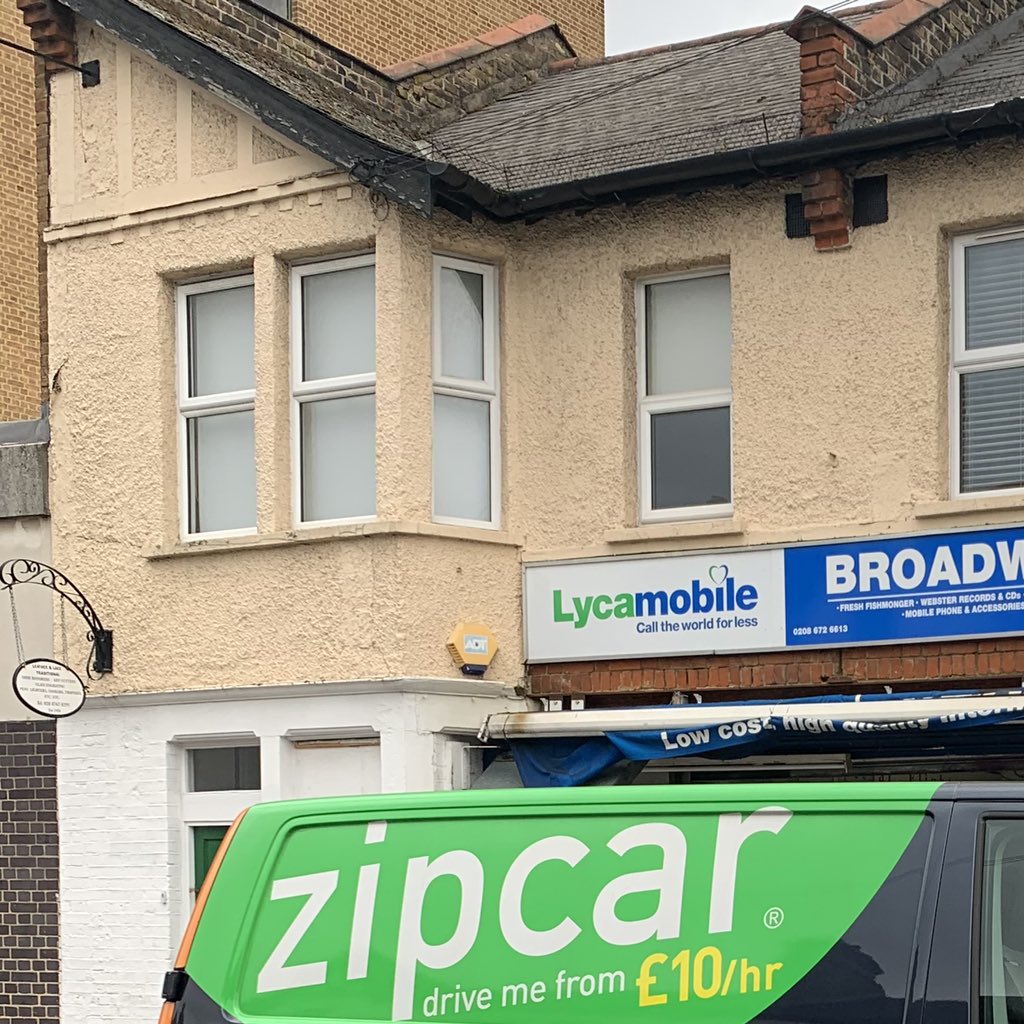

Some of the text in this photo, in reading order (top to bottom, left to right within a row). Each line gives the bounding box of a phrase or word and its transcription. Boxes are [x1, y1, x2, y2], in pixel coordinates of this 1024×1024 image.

[553, 576, 758, 629] Lycamobile
[839, 602, 864, 612] FRESH
[865, 599, 914, 611] FISHMONGER
[920, 595, 957, 607] WEBSTER
[959, 592, 996, 604] RECORDS
[998, 592, 1004, 601] &
[905, 607, 935, 619] MOBILE
[936, 605, 963, 616] PHONE
[964, 605, 970, 615] &
[636, 616, 759, 634] Call the world for less
[813, 625, 828, 635] 672
[659, 730, 710, 750] Low
[256, 805, 794, 1022] zipcar
[422, 945, 784, 1018] drive me from £10/hr
